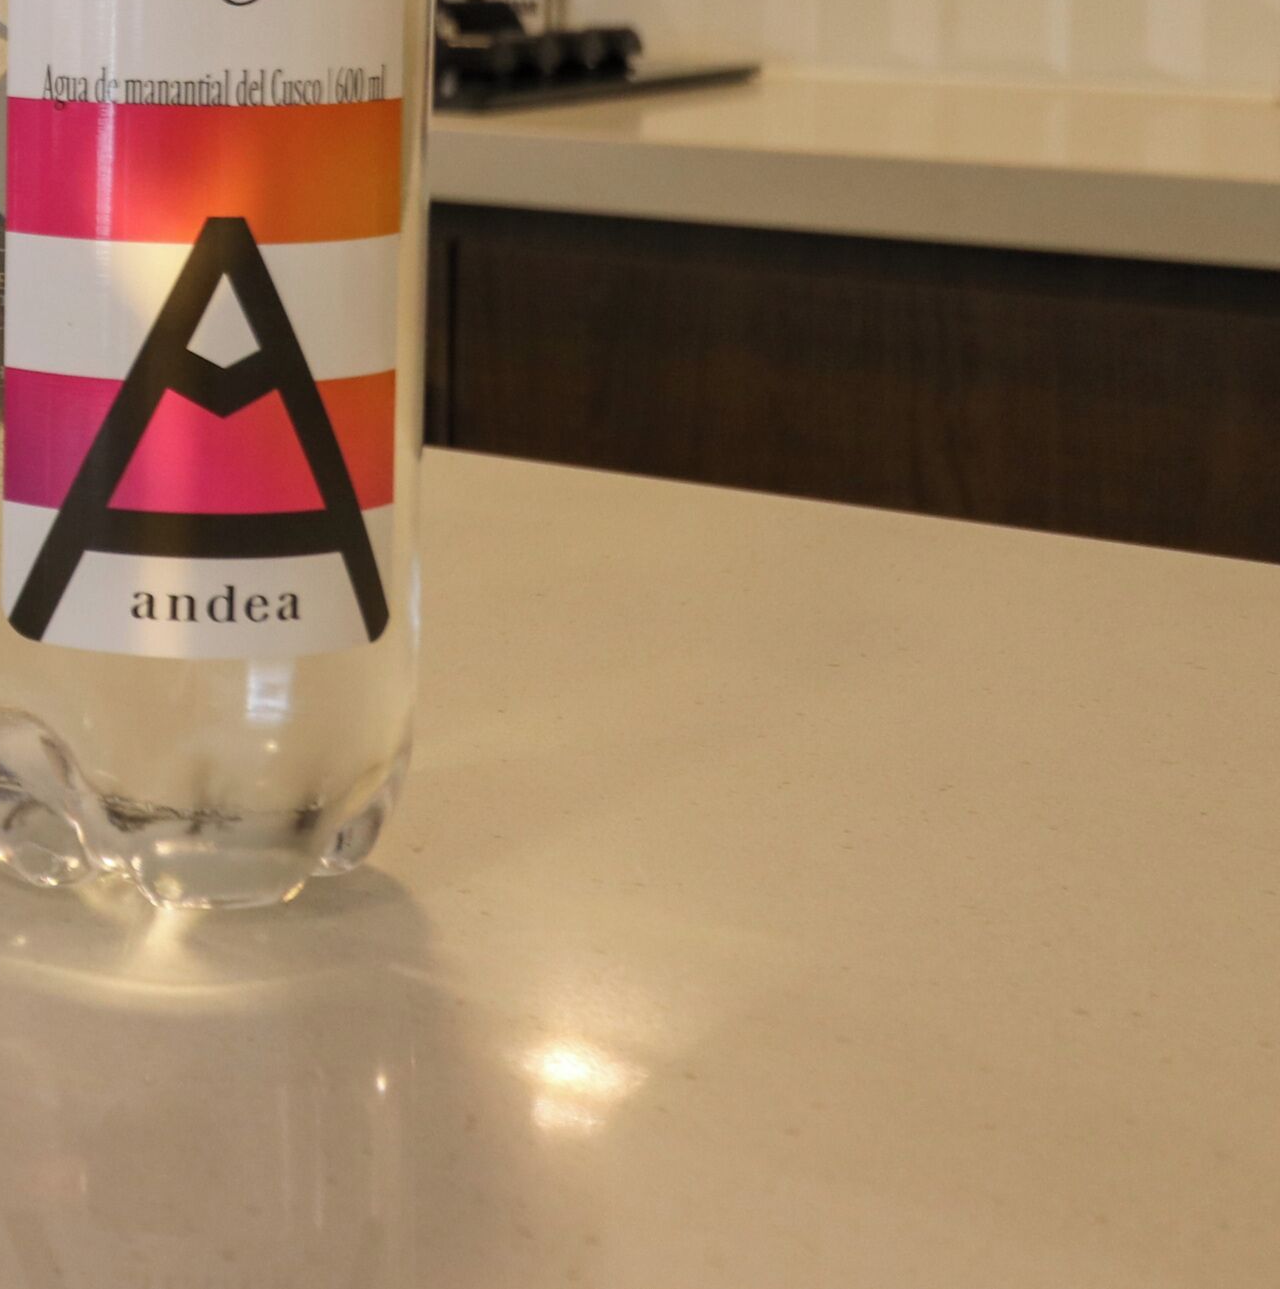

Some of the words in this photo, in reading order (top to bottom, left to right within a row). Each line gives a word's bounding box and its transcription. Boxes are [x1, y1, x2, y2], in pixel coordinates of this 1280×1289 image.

[42, 63, 88, 111] Agua
[95, 66, 118, 103] de
[125, 69, 230, 107] manantial
[236, 68, 265, 107] del
[271, 68, 322, 106] Cusco
[335, 66, 364, 104] 600
[368, 64, 385, 101] ml
[131, 585, 302, 623] andea
